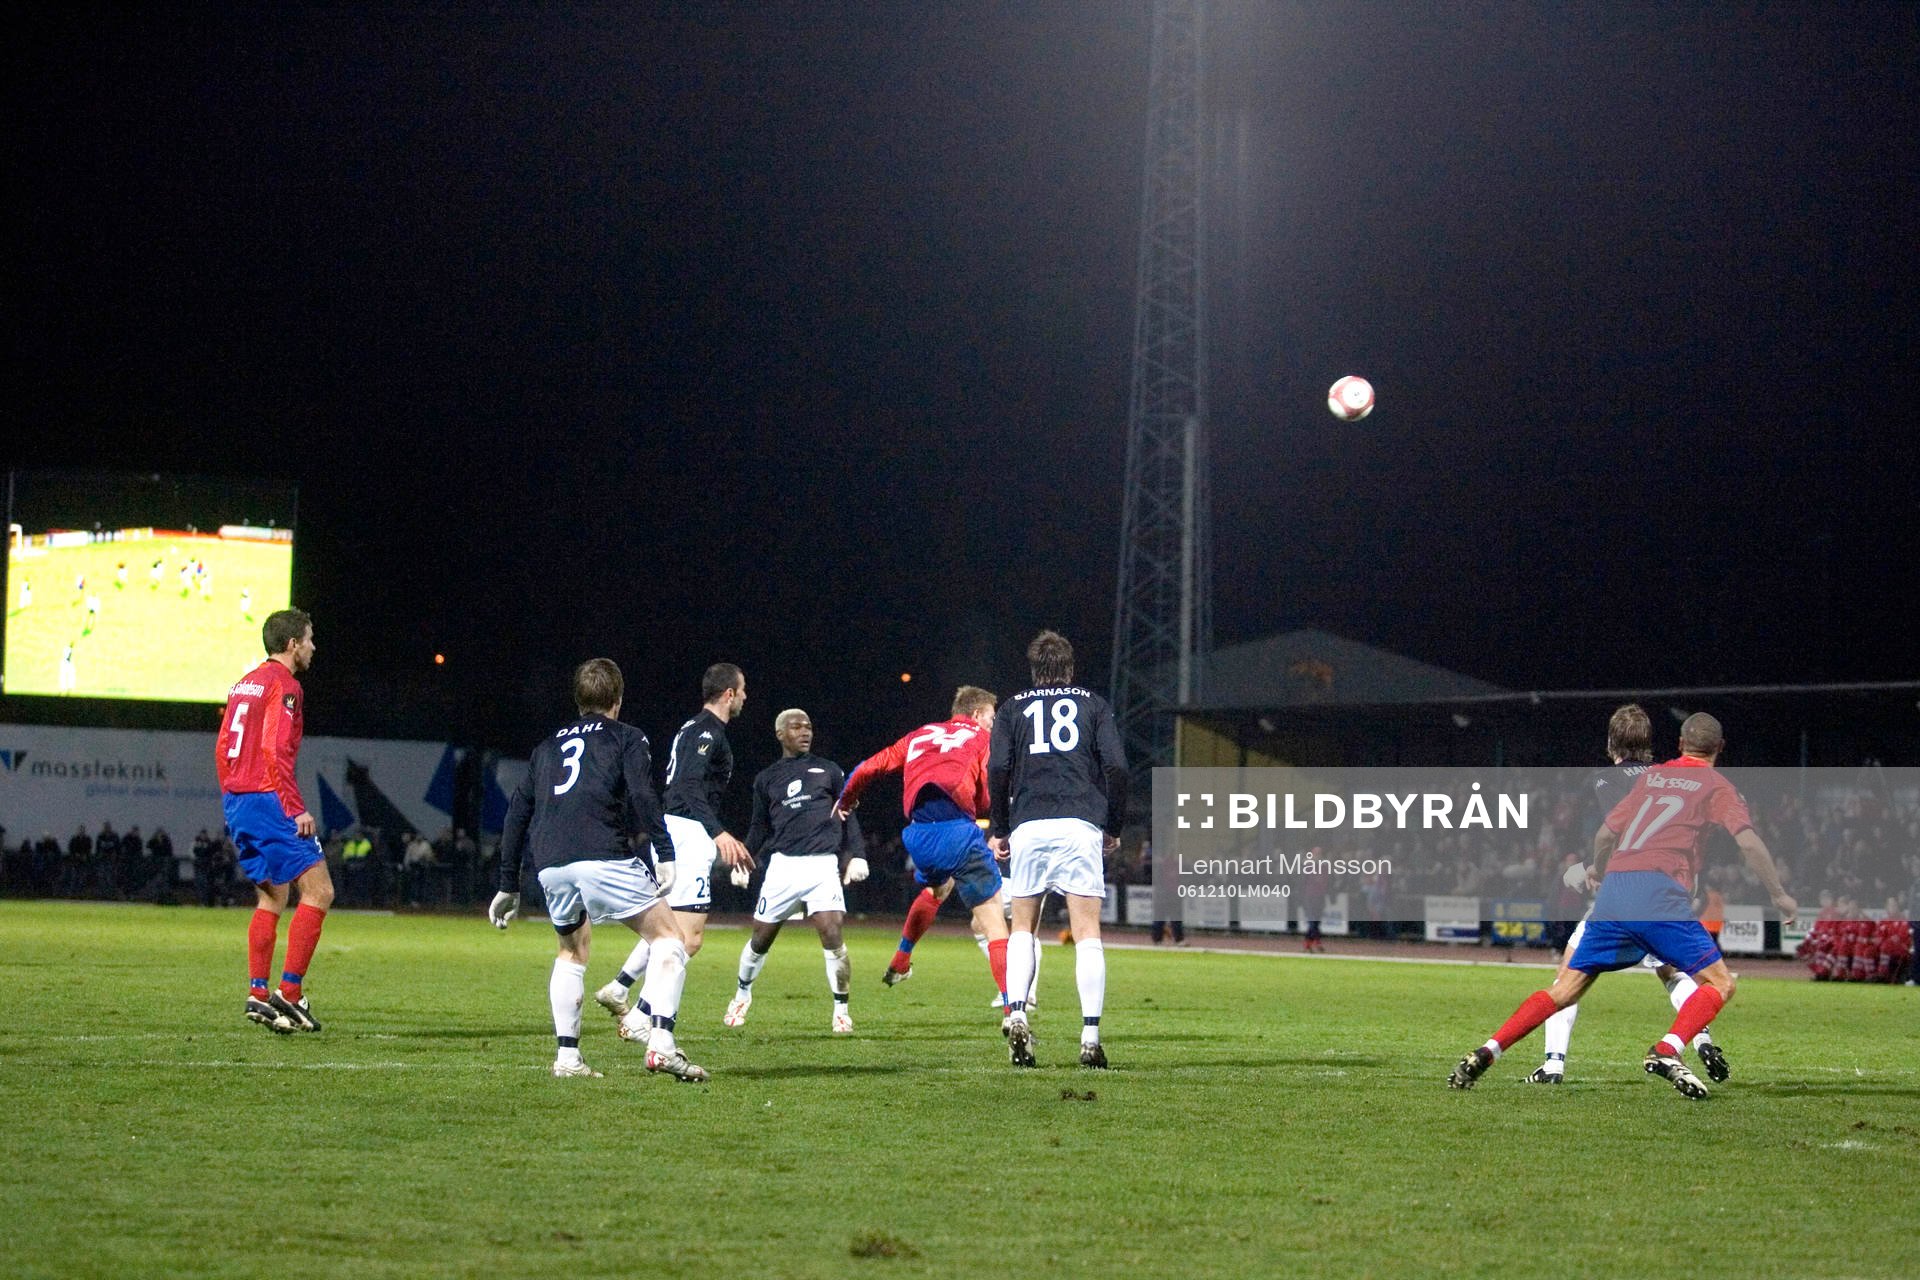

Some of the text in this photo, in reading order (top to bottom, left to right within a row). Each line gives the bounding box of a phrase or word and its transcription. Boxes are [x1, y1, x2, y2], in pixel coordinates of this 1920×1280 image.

[1013, 687, 1091, 700] BJARNASON
[228, 701, 250, 758] 5
[556, 722, 604, 738] DAHL
[907, 724, 977, 763] 24
[1022, 698, 1079, 755] 18
[553, 737, 585, 796] 3
[1618, 794, 1684, 851] 17
